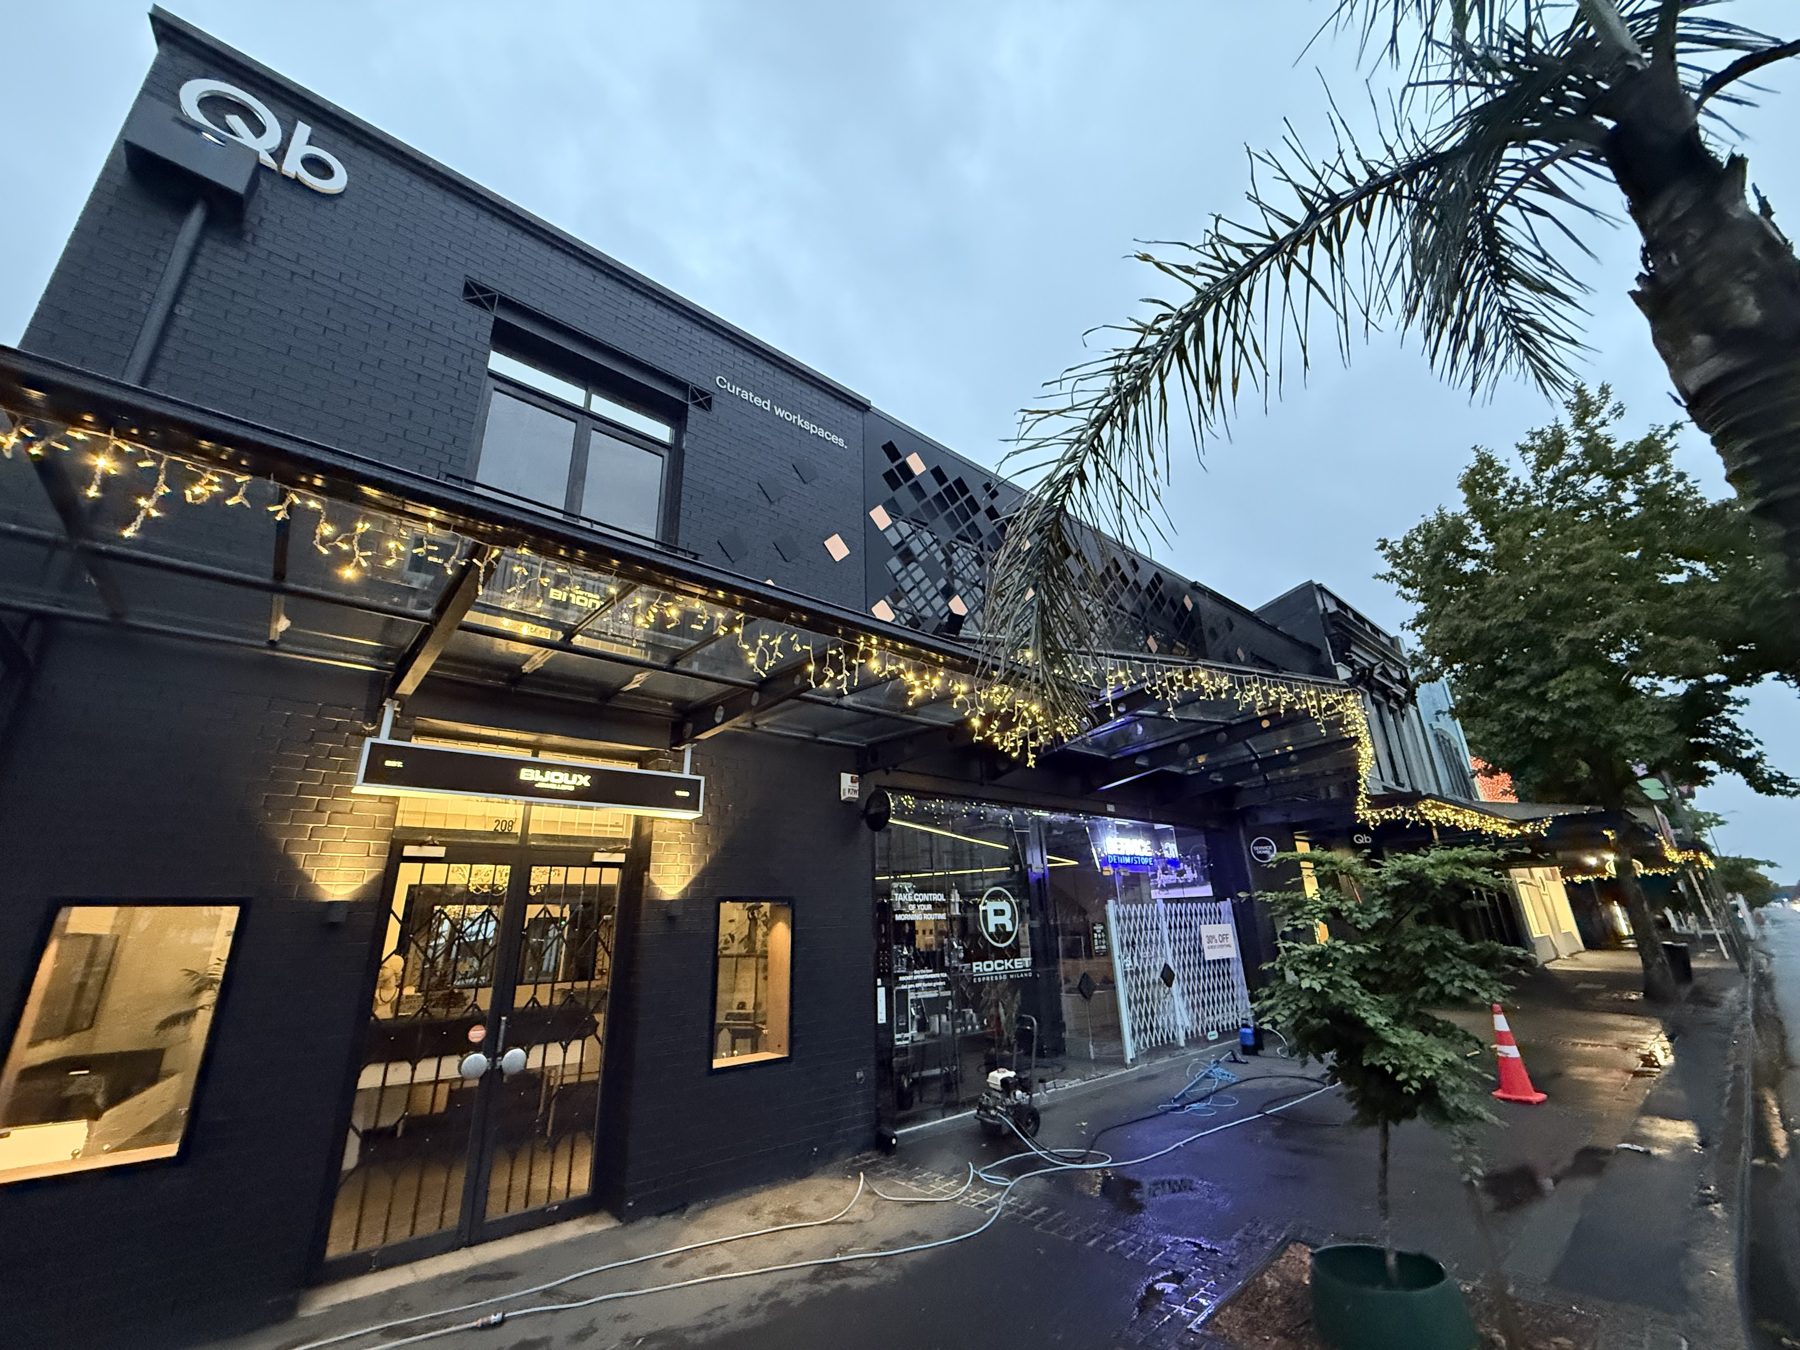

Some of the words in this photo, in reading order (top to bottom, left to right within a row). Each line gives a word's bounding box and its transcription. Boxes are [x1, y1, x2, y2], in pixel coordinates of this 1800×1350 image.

[179, 78, 348, 194] Qb
[715, 375, 771, 412] Curated
[773, 405, 848, 449] workspaces.
[519, 768, 592, 787] BIJOUX
[493, 819, 514, 832] 208
[1353, 834, 1372, 844] Qb
[894, 893, 913, 902] TAKE
[914, 892, 946, 902] CONTROL
[894, 913, 922, 921] MORNING
[923, 912, 947, 920] ROUTINE
[986, 900, 1013, 933] R
[1218, 933, 1229, 943] OFF
[972, 957, 1032, 973] ROCKET
[973, 974, 1007, 983] ESPRESSO
